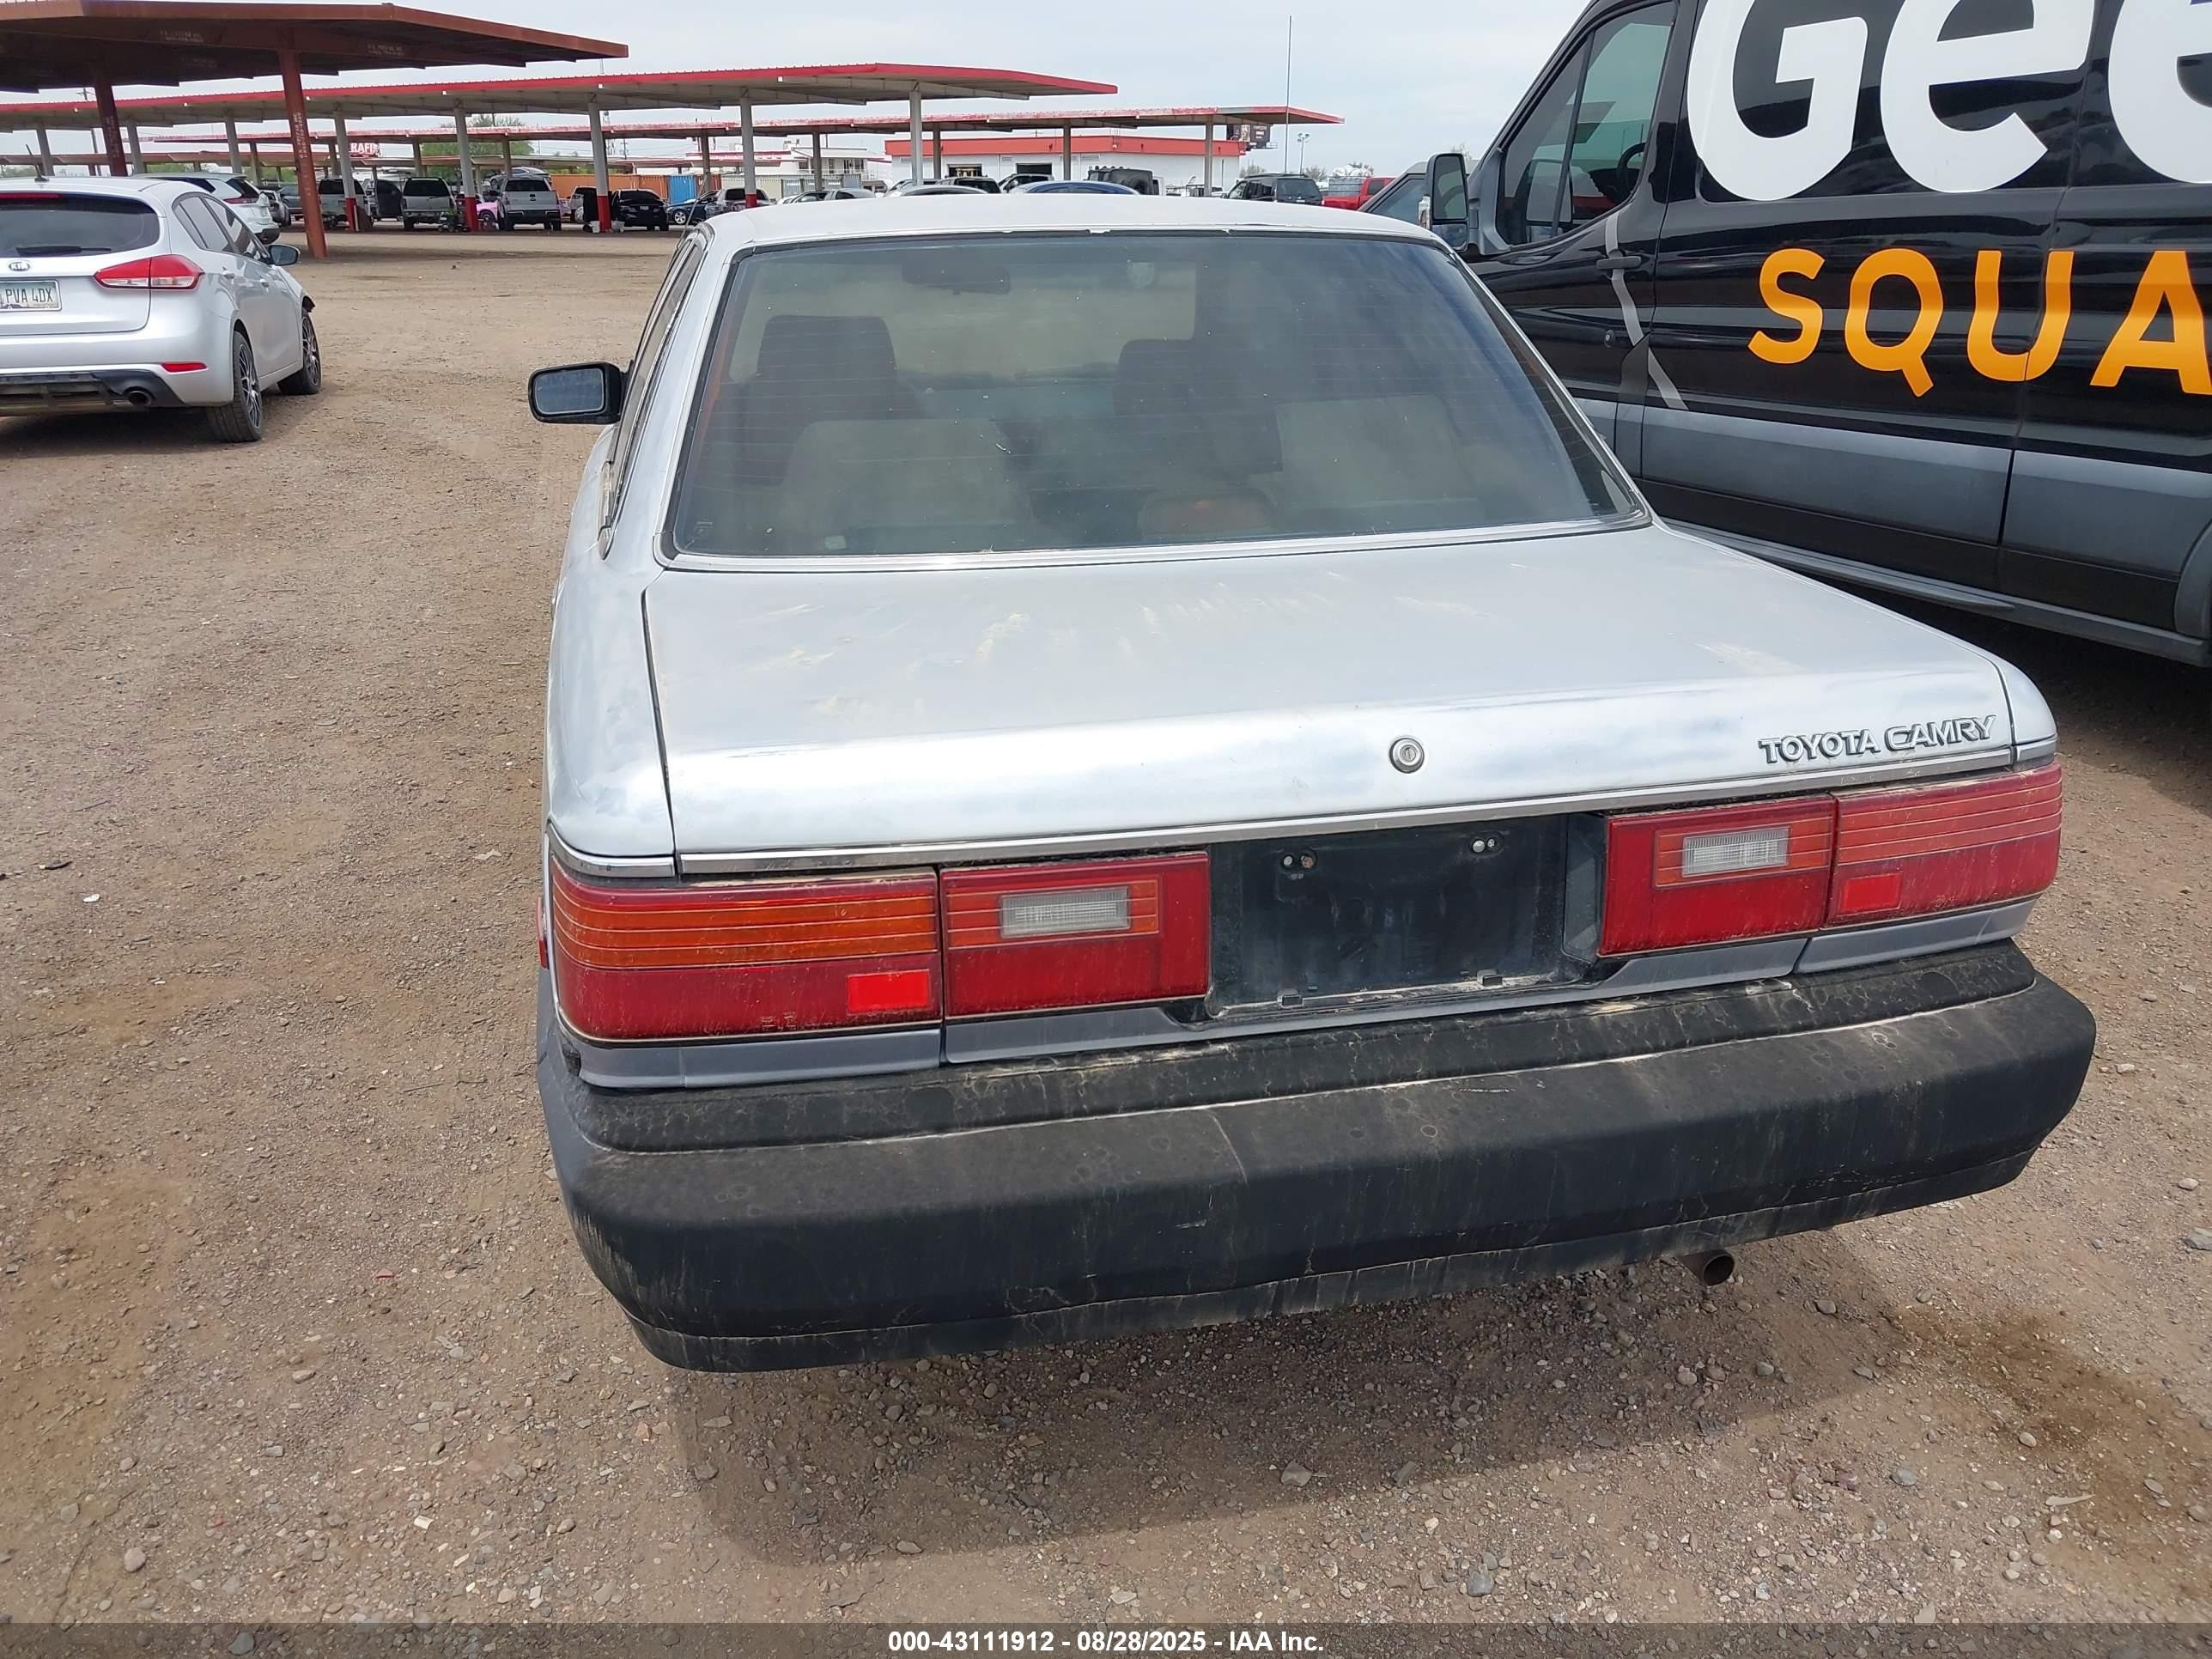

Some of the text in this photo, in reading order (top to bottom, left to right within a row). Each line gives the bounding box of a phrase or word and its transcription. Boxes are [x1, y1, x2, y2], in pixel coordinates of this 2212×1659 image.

[5, 288, 53, 303] PVA 4DX
[1748, 248, 2212, 396] SQUA
[1758, 714, 1996, 764] TOYOTA CAMRY
